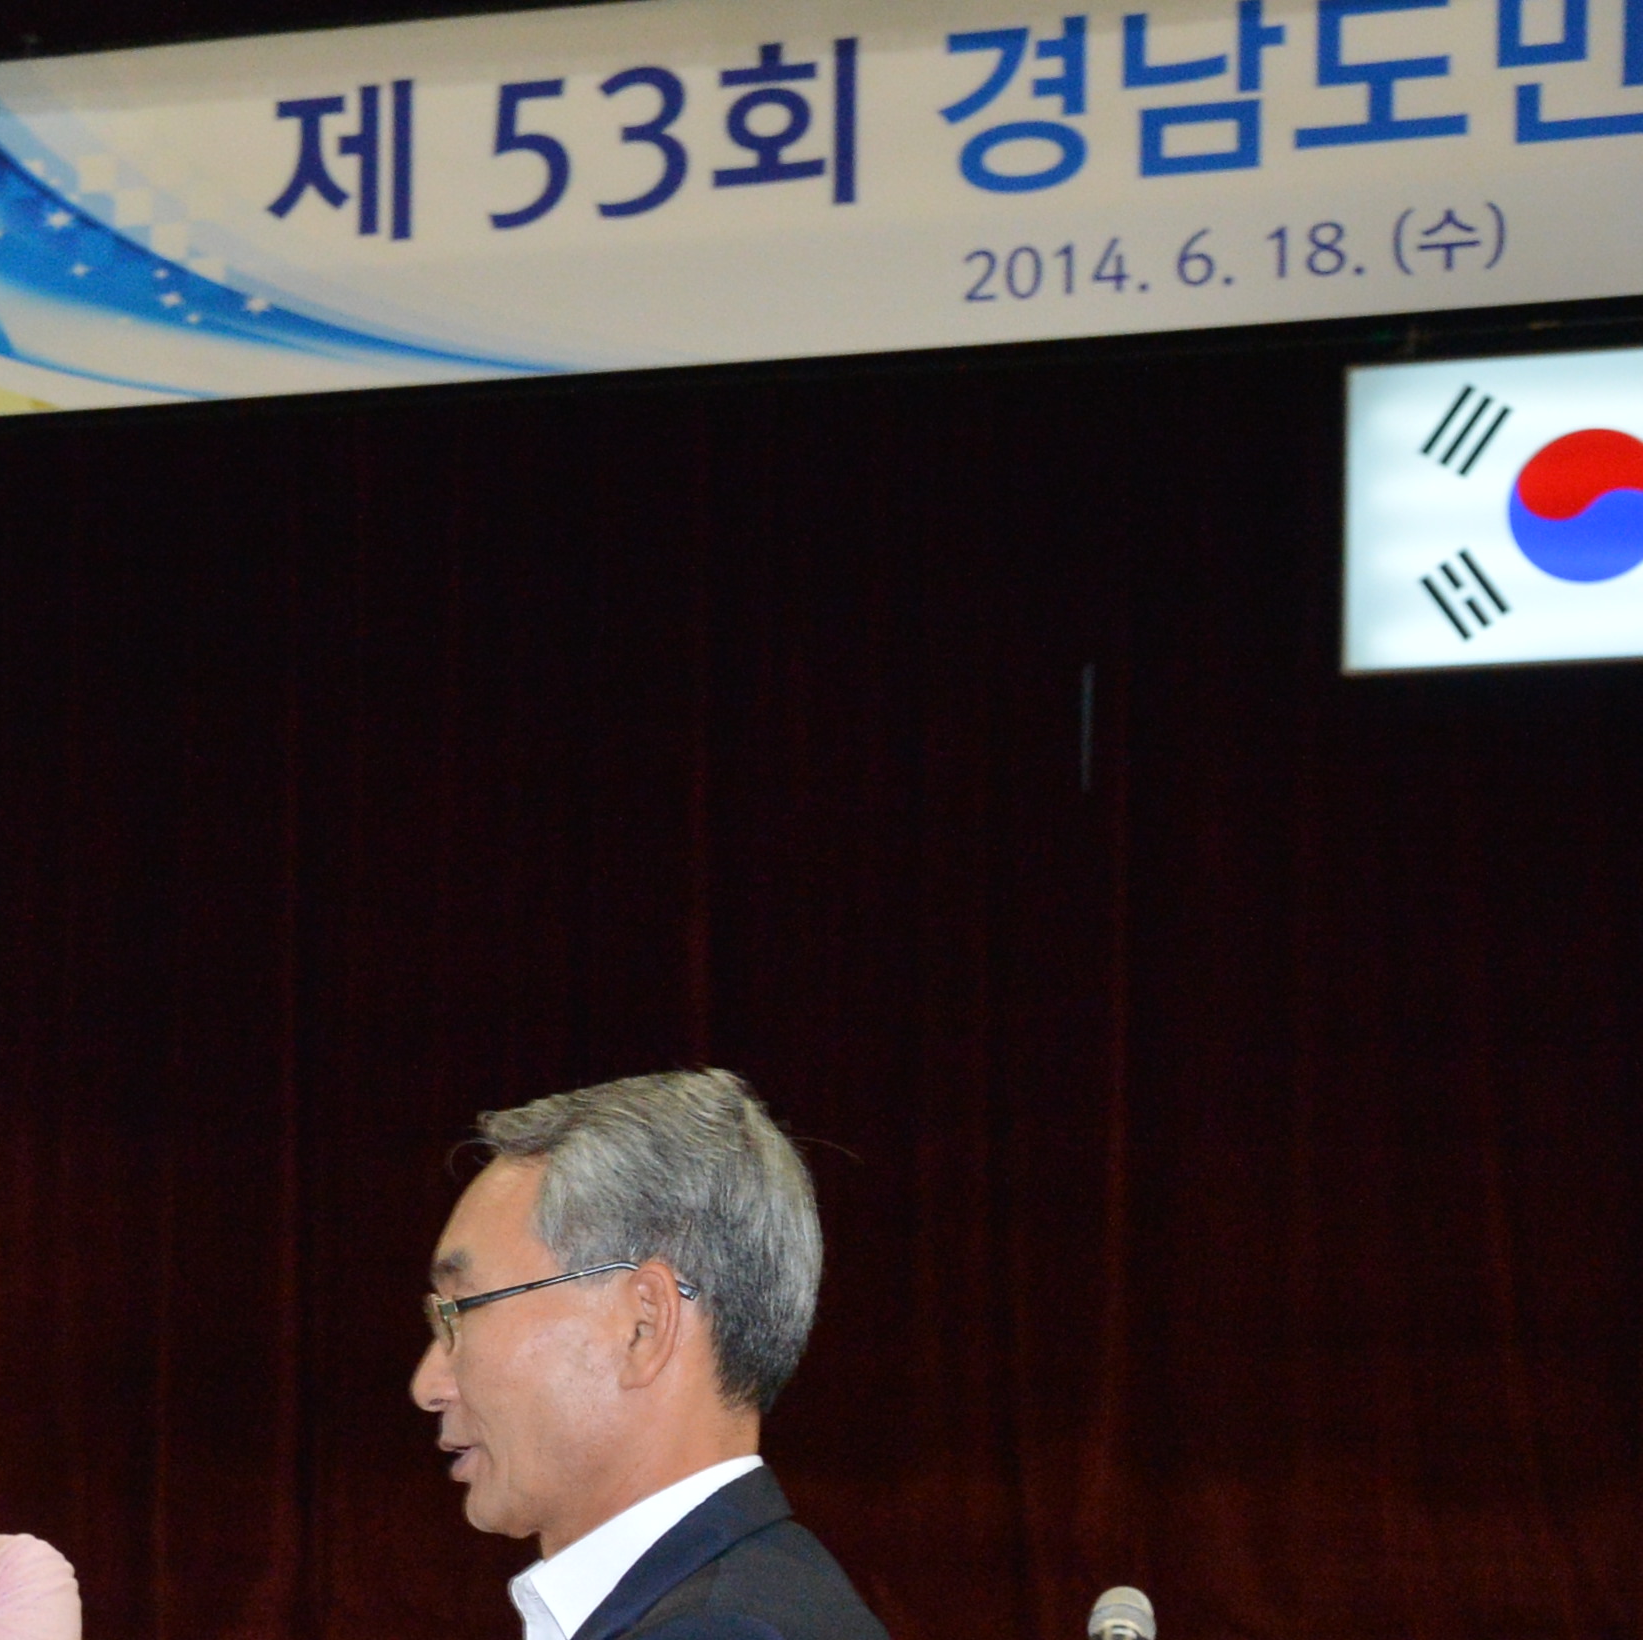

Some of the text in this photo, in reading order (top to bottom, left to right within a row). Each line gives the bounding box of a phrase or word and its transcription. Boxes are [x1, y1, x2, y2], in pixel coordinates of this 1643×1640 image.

[266, 78, 415, 241] 제
[489, 36, 859, 230] 53회
[963, 201, 1508, 303] 2014. 6. 18. (수)
